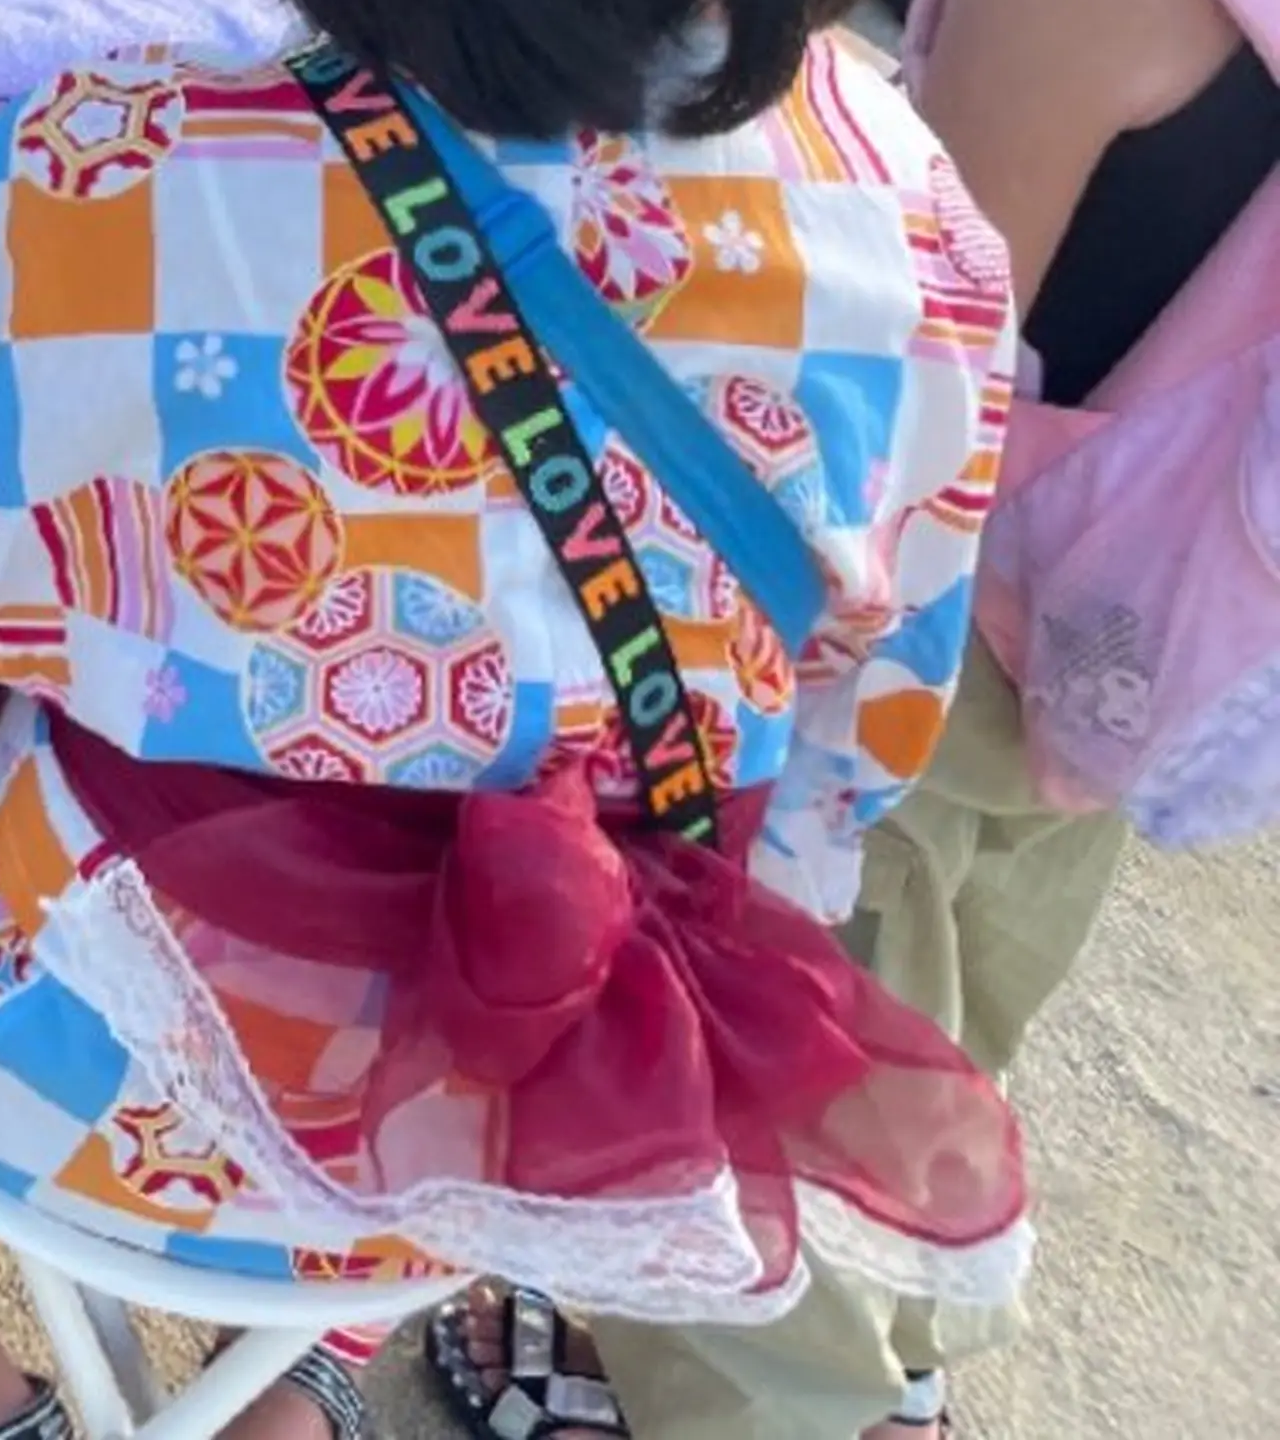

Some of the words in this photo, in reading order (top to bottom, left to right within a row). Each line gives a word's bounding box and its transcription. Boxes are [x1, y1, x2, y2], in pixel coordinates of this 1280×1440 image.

[384, 176, 536, 395] LOVE
[501, 408, 638, 621] LOVE
[609, 625, 705, 816] LOVE
